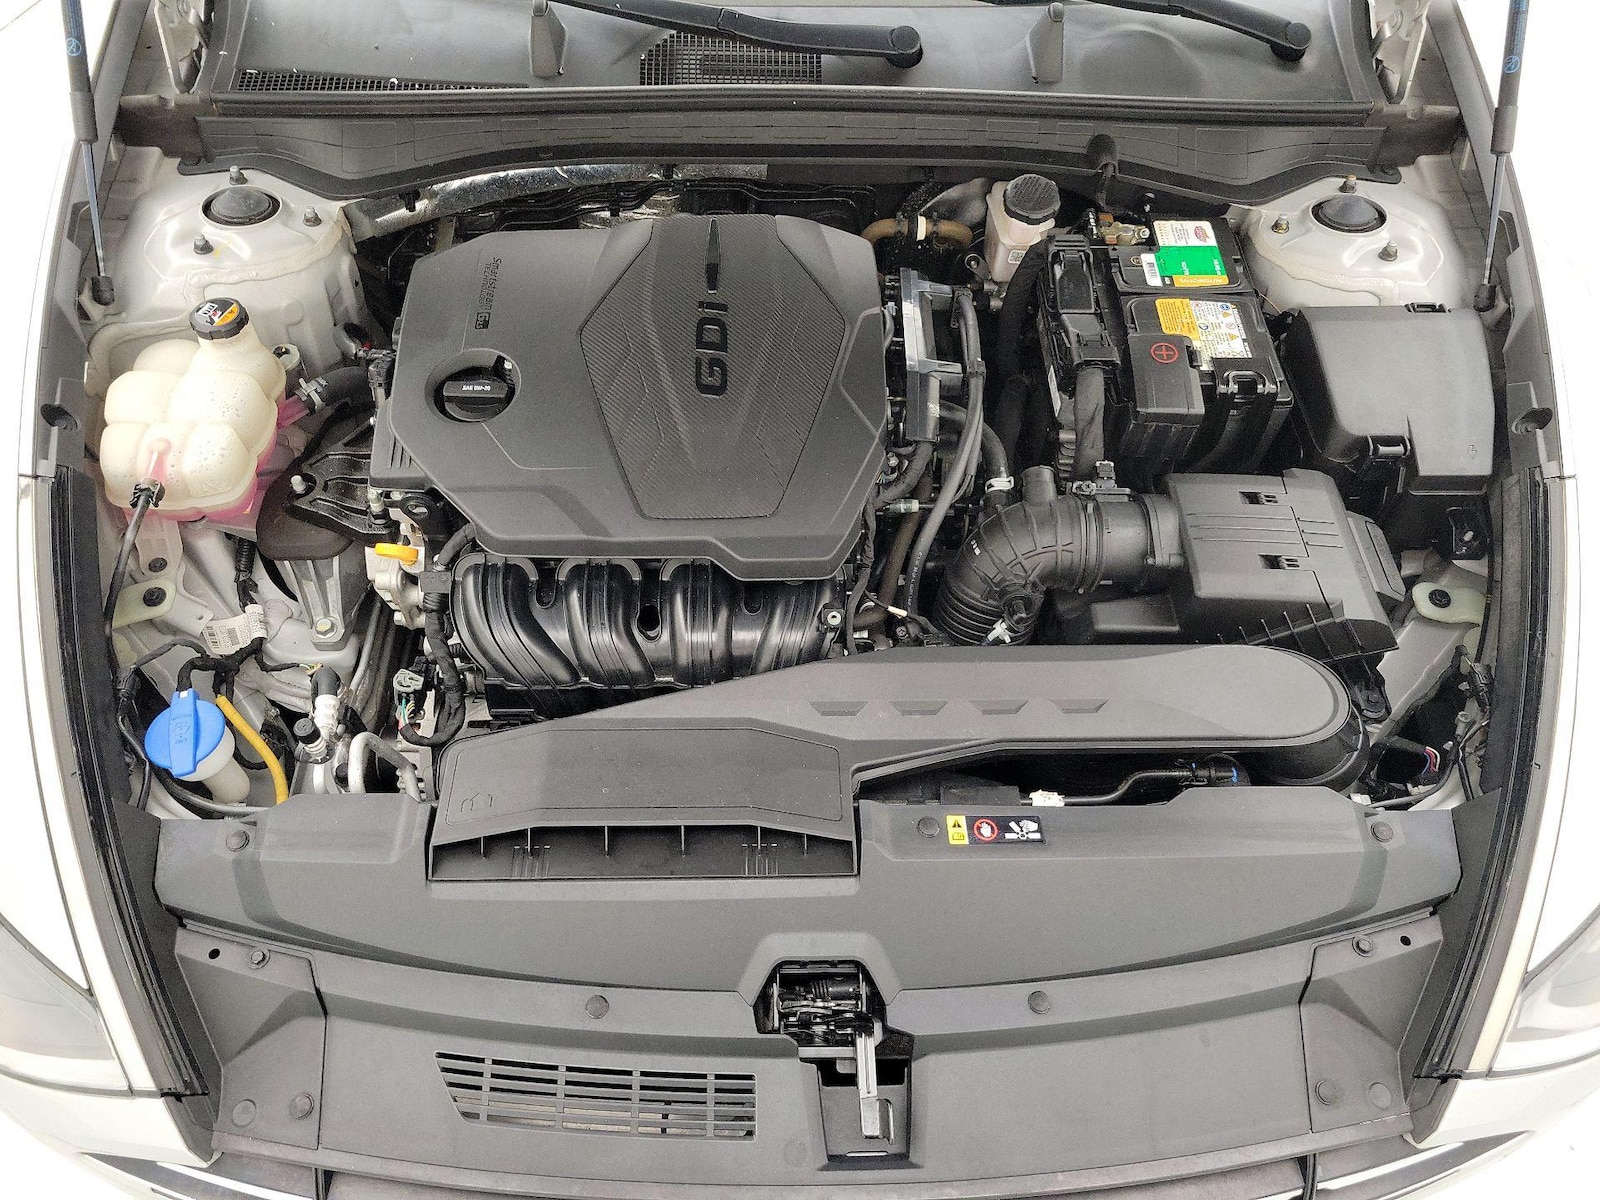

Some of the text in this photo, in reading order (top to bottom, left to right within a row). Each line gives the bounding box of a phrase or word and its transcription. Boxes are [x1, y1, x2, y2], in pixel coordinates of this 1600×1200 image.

[479, 262, 491, 309] TECHNOLOGY
[485, 257, 502, 310] Smartstream
[695, 301, 728, 397] GDi
